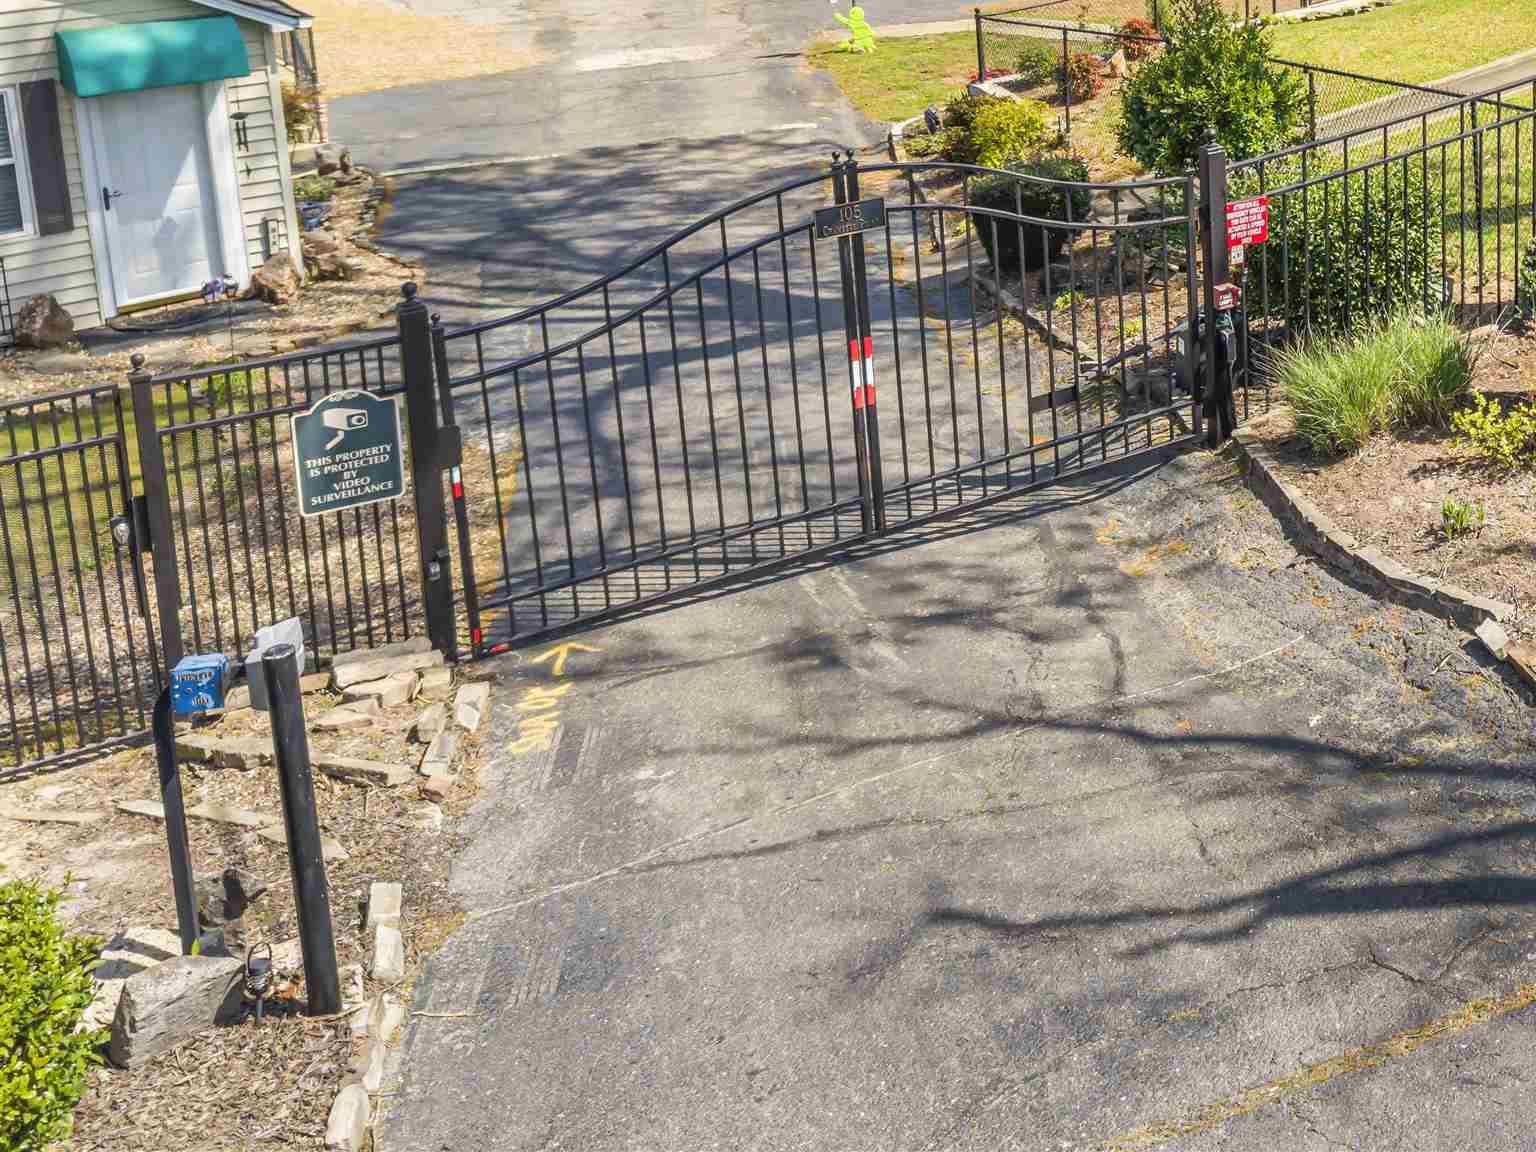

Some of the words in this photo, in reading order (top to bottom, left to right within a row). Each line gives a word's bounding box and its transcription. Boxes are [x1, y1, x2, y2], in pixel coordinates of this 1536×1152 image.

[304, 456, 331, 468] THIS
[336, 444, 392, 460] PROPERTY
[310, 469, 320, 478] IS
[323, 454, 390, 474] PROTECTED
[333, 476, 371, 491] VIDEO
[344, 470, 357, 479] BY
[311, 480, 394, 506] SURVEILLANCE
